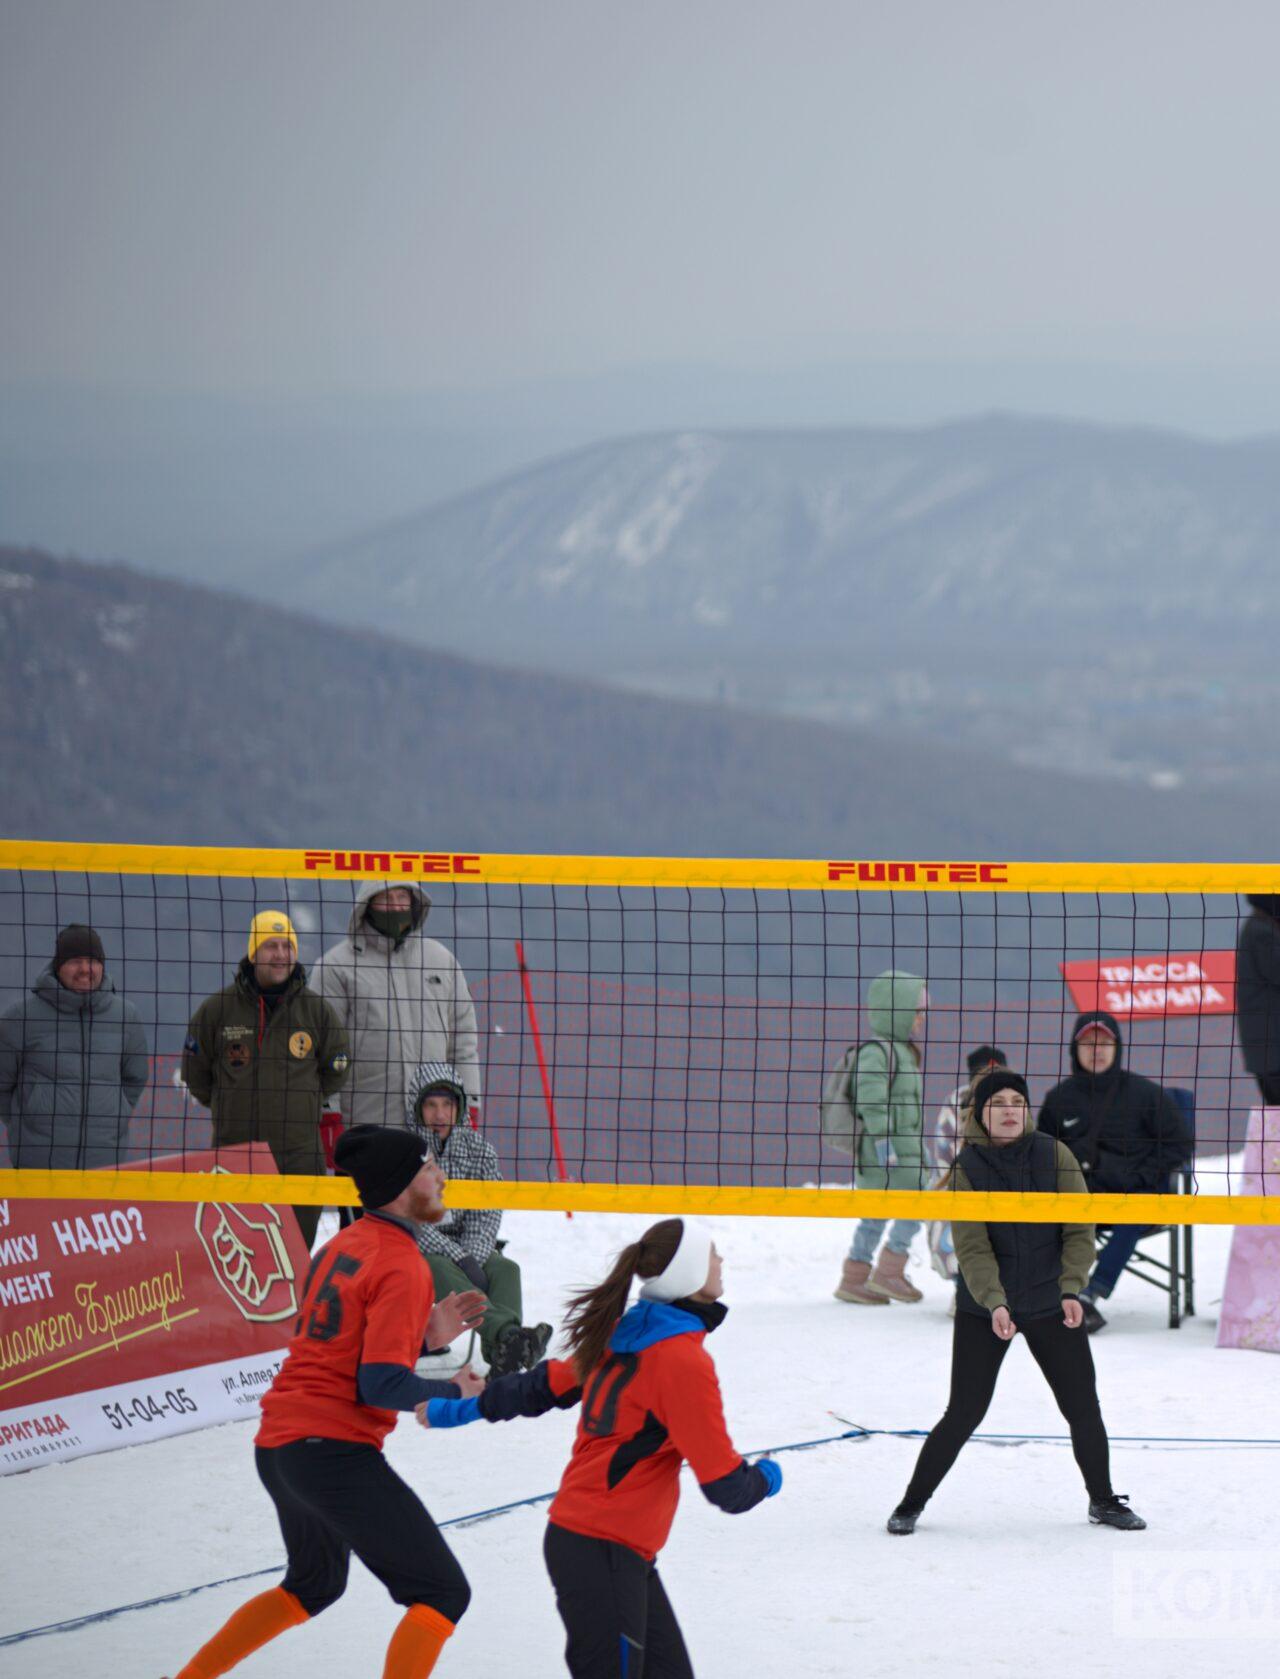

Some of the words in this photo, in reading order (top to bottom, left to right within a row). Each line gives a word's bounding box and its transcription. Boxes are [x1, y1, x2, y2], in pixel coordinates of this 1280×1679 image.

[305, 851, 481, 874] FUNTEC
[828, 862, 1008, 883] FUNTEC
[1100, 960, 1208, 988] ТРАССА
[1105, 983, 1226, 1013] ЗАКРЫТА
[51, 1206, 147, 1256] НАДО?
[0, 1233, 39, 1268] ИКУ
[74, 1250, 186, 1352] Бригада!
[101, 1387, 199, 1431] 51-04-05
